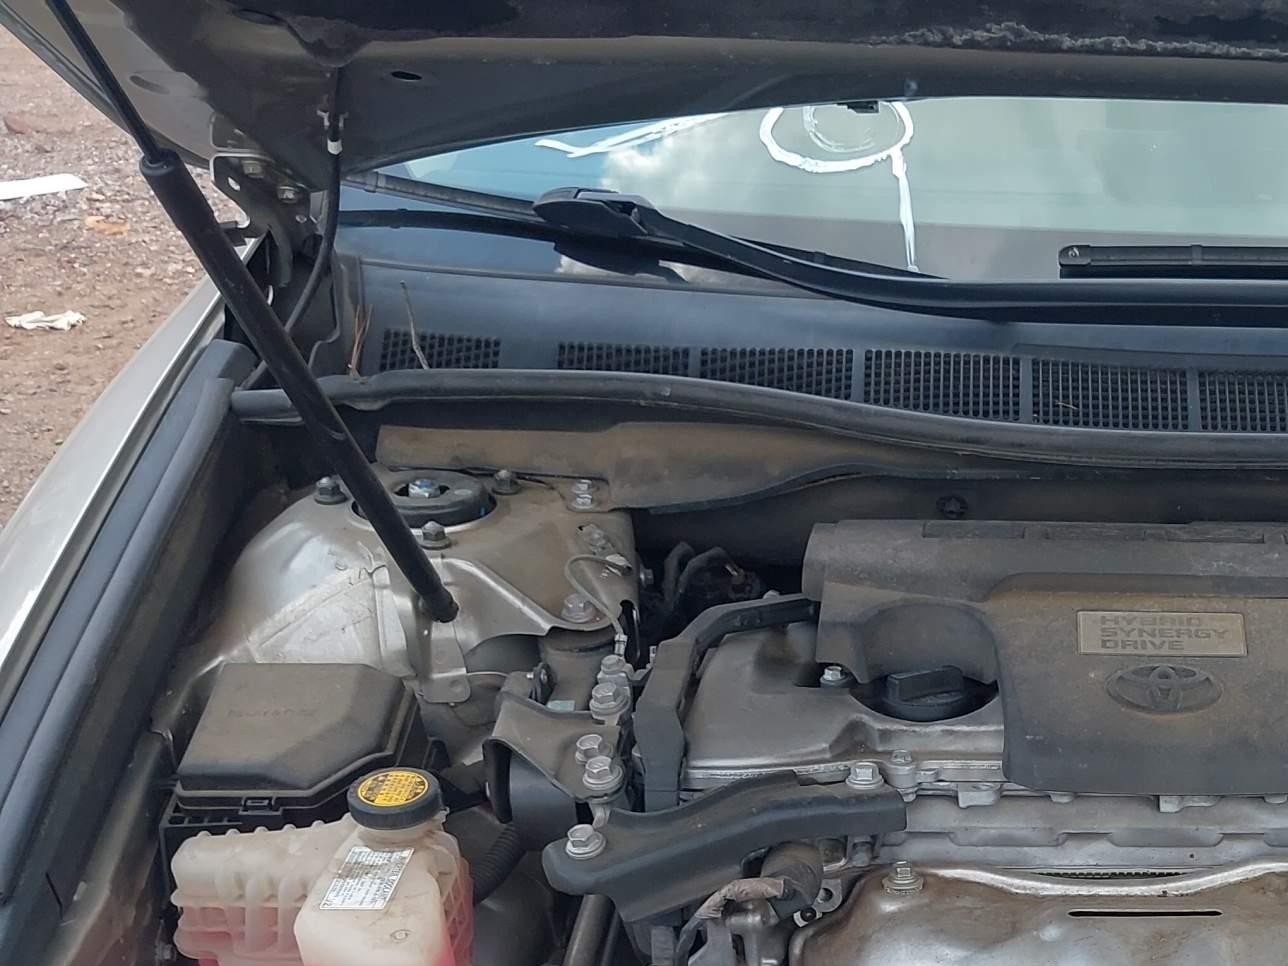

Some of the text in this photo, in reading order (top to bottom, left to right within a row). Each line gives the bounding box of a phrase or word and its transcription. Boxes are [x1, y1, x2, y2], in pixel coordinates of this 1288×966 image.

[1101, 615, 1202, 627] HYBRID
[1101, 627, 1229, 639] SYNERGY
[1101, 639, 1185, 651] DRIVE
